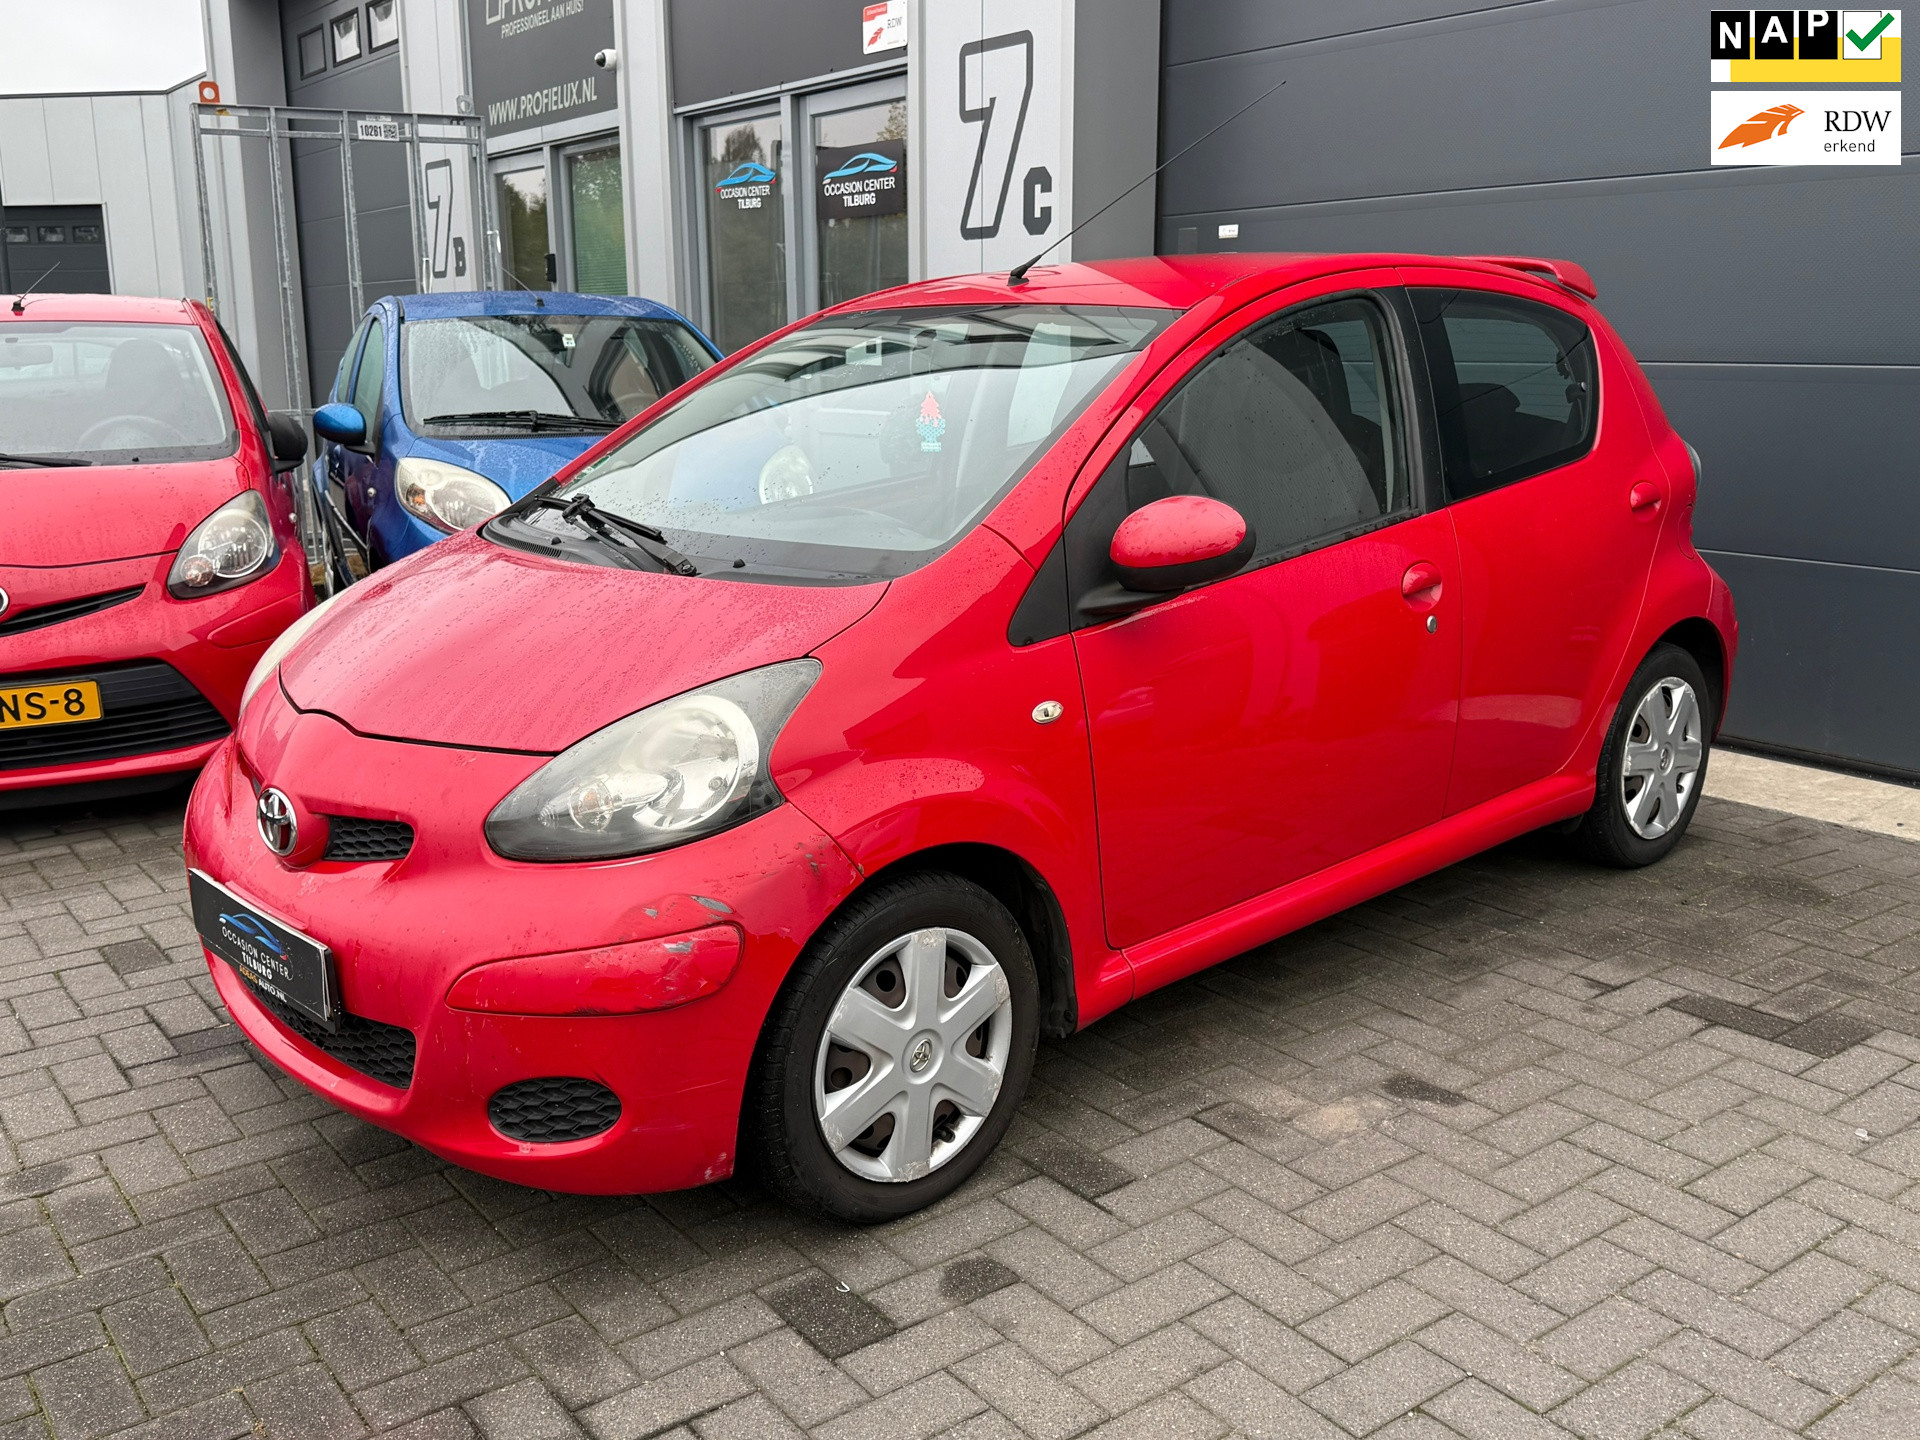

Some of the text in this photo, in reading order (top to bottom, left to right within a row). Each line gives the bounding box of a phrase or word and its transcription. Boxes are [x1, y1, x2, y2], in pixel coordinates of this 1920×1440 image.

[501, 9, 550, 39] PROFESSIONEEL
[550, 3, 565, 22] AAN
[888, 16, 903, 29] RDW
[488, 76, 598, 126] WWW.PROFIELUX.NL
[360, 124, 382, 137] 10261
[720, 185, 771, 199] OCCASION CENTER
[823, 176, 896, 196] OCCASION CENTER
[737, 198, 762, 209] TILBURG
[842, 192, 876, 208] TILBURG
[221, 926, 290, 980] OCCASION CENTER
[241, 951, 273, 980] TILBURG
